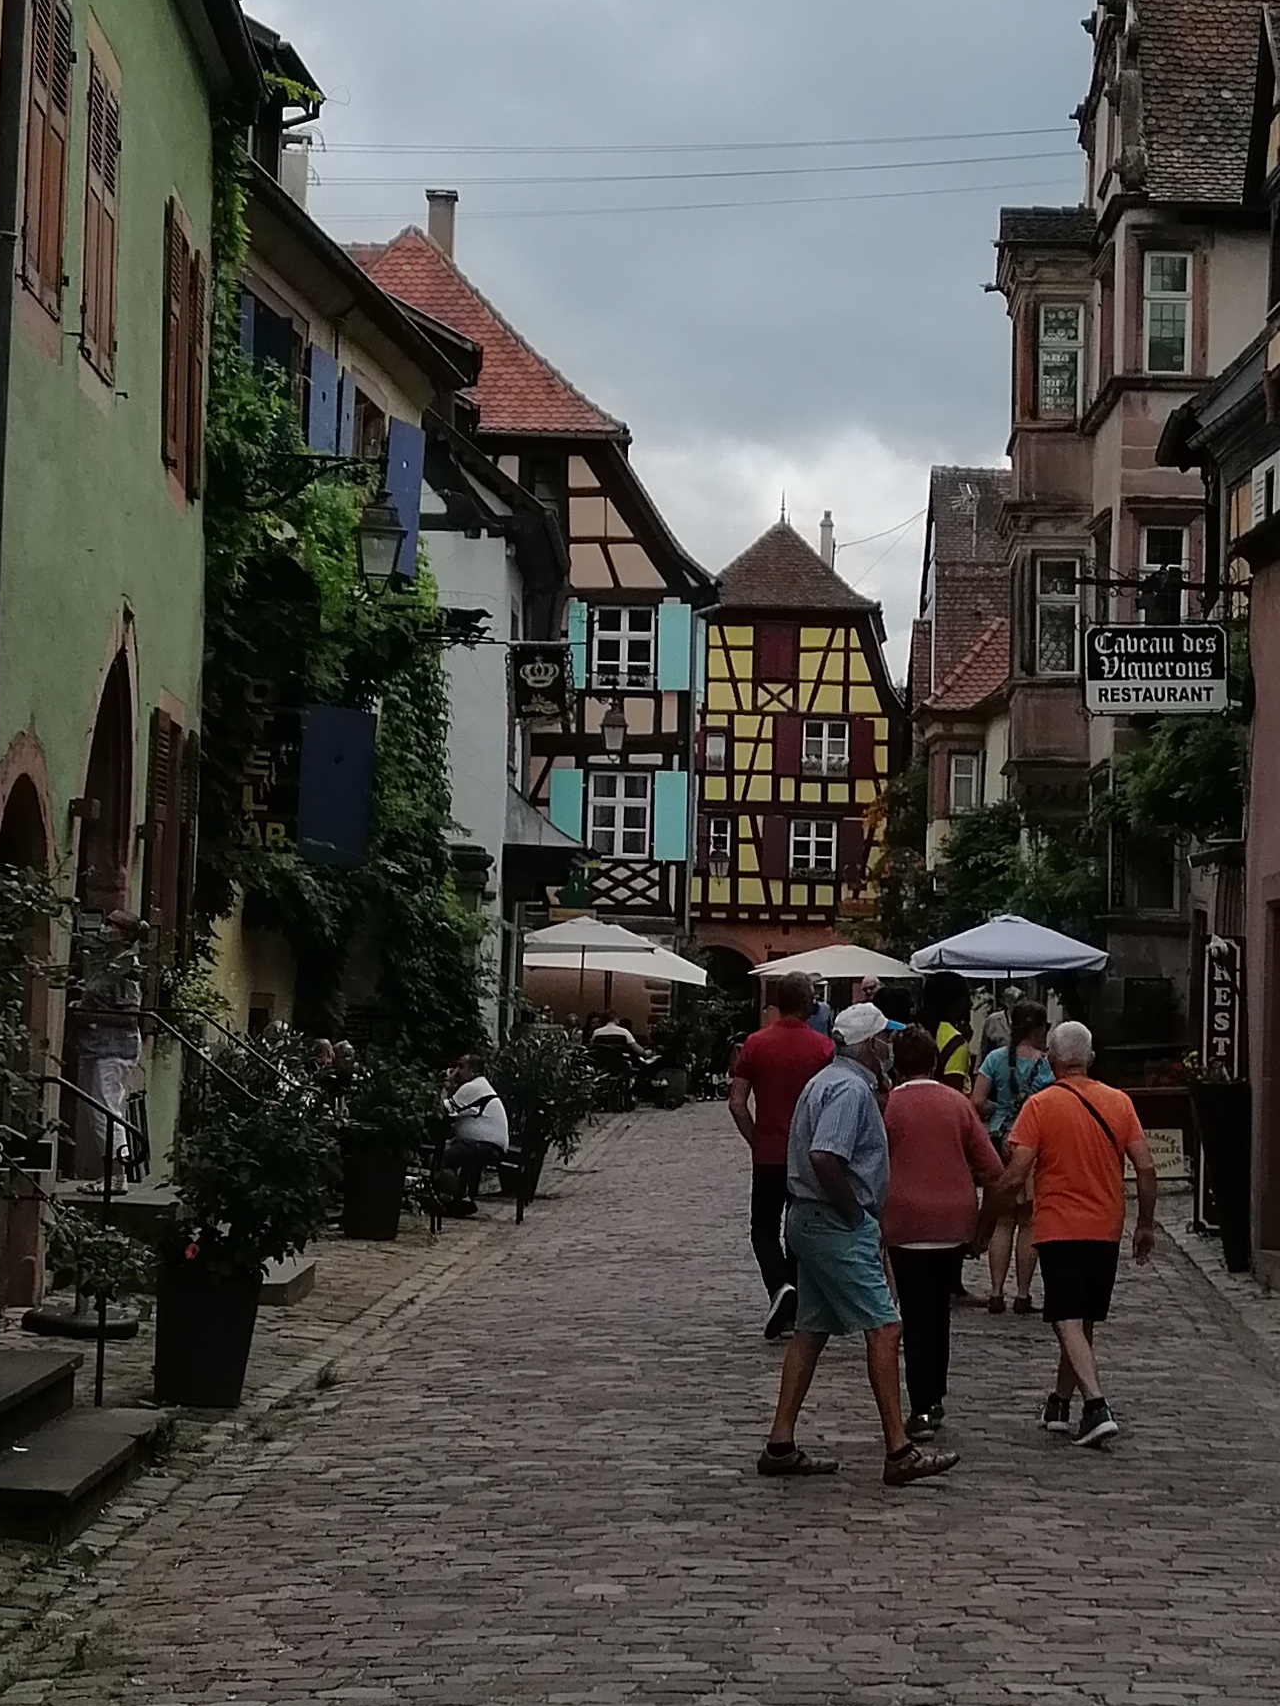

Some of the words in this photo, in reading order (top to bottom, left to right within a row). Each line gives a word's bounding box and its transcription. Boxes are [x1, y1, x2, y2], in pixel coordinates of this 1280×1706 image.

[1094, 631, 1175, 654] Caveau
[1181, 632, 1218, 654] des
[1099, 655, 1213, 681] Vignerons
[1097, 686, 1215, 703] RESTAURANT
